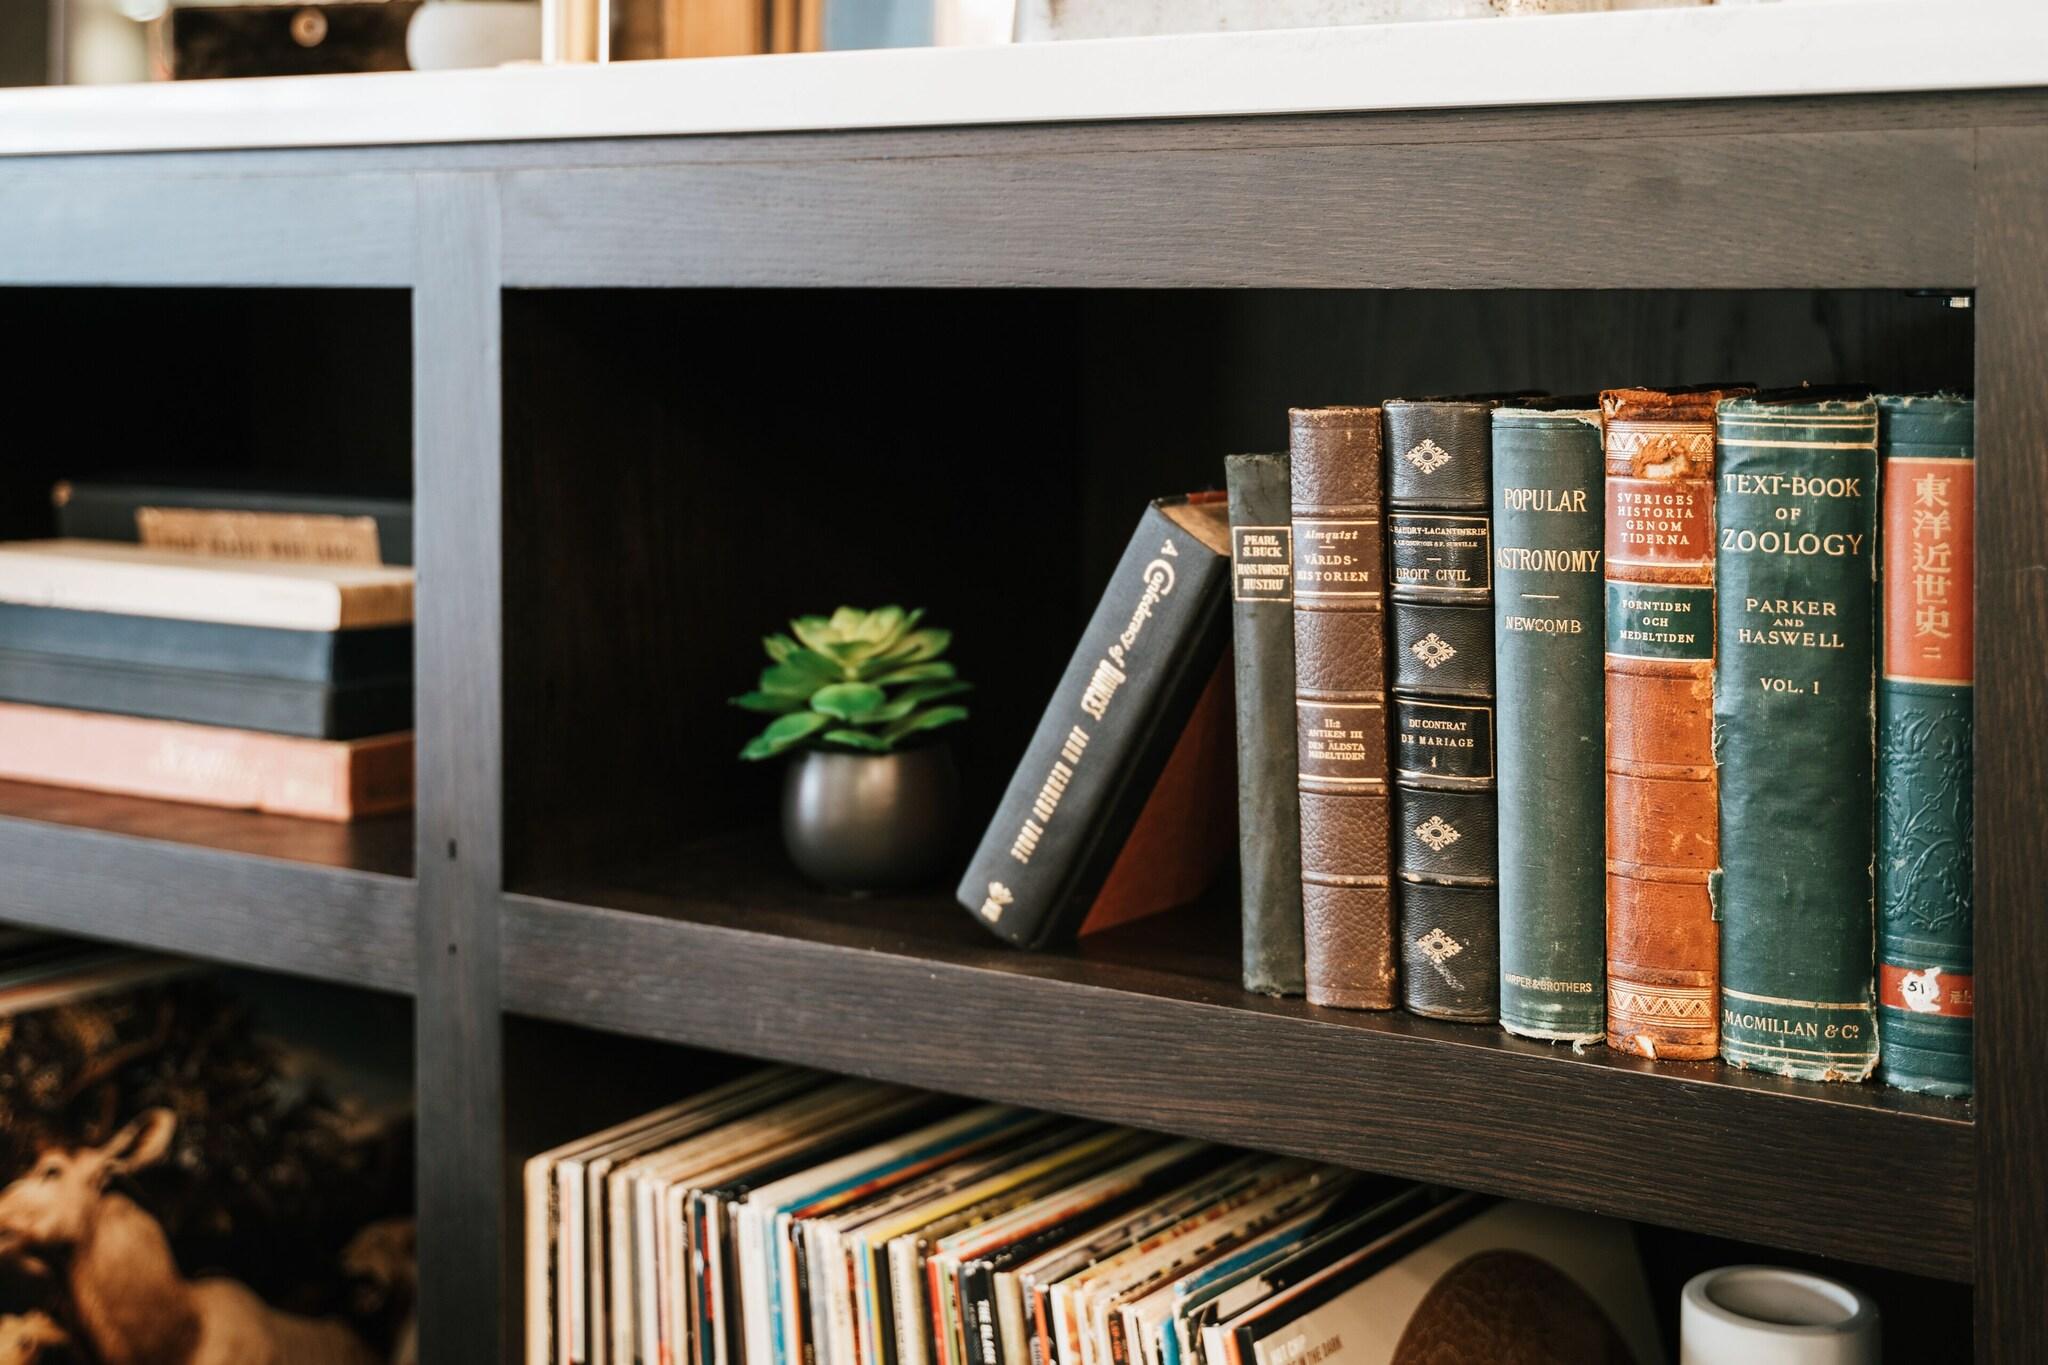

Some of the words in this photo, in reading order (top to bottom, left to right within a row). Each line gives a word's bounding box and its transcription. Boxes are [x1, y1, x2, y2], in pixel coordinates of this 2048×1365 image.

[1723, 473, 1861, 498] TEXT-BOOK
[1503, 488, 1588, 513] POPULAR
[1617, 493, 1694, 506] SVERIGES
[1617, 505, 1695, 519] HISTORIA
[1775, 507, 1802, 521] OF
[1626, 519, 1683, 532] GENOM
[1243, 535, 1279, 546] PEARL
[1620, 532, 1690, 546] TIDERNA
[1721, 528, 1863, 556] ZOOLOGY
[1160, 539, 1178, 557] A
[1496, 548, 1600, 573] ASTRONOMY
[1911, 472, 1952, 639] 東洋近世史
[1396, 568, 1430, 581] DROIT
[1436, 570, 1471, 582] CIVIL
[1622, 600, 1692, 613] FORNTIDEN
[1746, 598, 1837, 616] PARKER
[1505, 616, 1582, 633] NEWCOMB
[1642, 617, 1669, 627] OCH
[1773, 618, 1804, 628] AND
[1619, 630, 1695, 644] MEDELTIDEN
[1738, 629, 1844, 648] HASWELL
[1109, 645, 1125, 669] of
[1760, 678, 1804, 694] VOL.
[1408, 718, 1421, 729] DU
[1422, 719, 1467, 731] CONTRAT
[1401, 734, 1415, 744] DE
[1419, 737, 1474, 748] MARIAGE
[1540, 981, 1593, 993] BROTHERS
[1724, 1009, 1818, 1037] MACMILLAN
[1824, 1024, 1839, 1039] &
